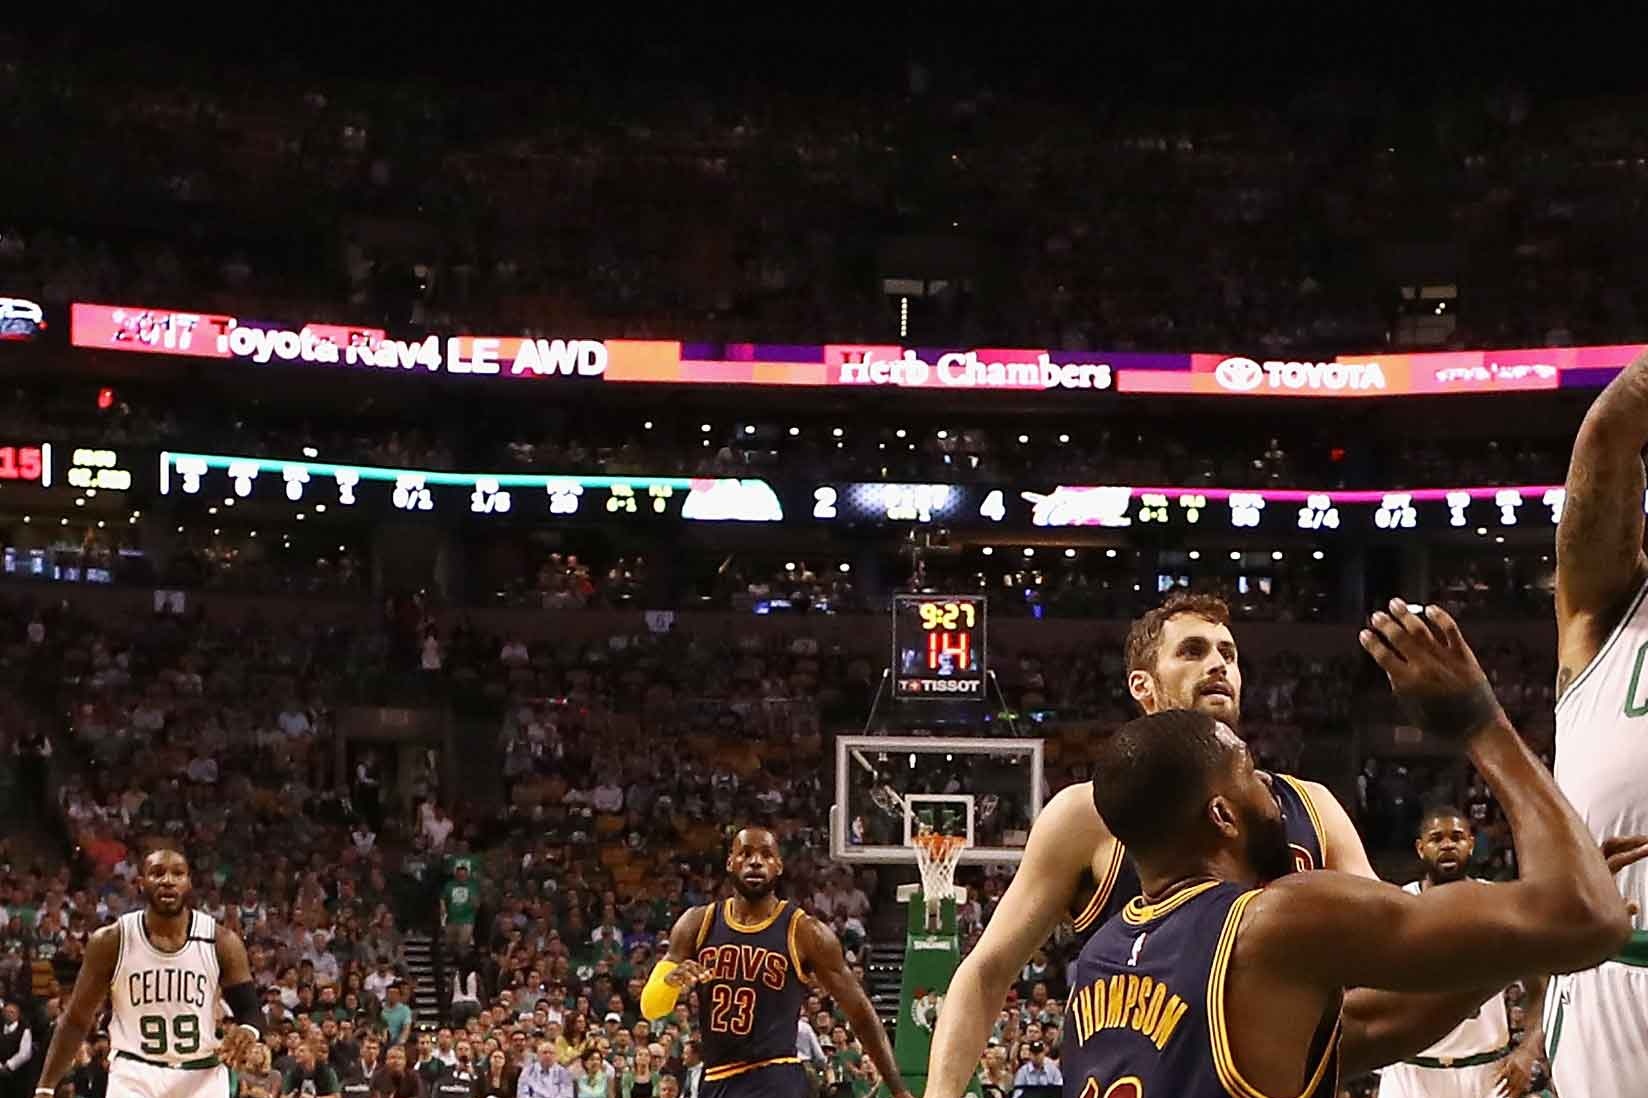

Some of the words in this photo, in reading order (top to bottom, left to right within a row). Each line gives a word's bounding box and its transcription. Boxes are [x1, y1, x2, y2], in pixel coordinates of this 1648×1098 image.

[208, 317, 340, 364] Toyota
[345, 330, 442, 372] Rav4
[448, 336, 500, 374] LE
[511, 338, 608, 376] AWD
[839, 350, 930, 385] Herb
[937, 351, 1112, 389] Chambers
[1263, 362, 1386, 389] TOYOTA
[813, 486, 838, 518] 2
[979, 490, 1006, 521] 4
[1297, 507, 1340, 529] 2/4
[919, 603, 976, 630] 9:27
[928, 632, 975, 670] 14
[924, 679, 980, 692] TISSOT
[699, 944, 788, 990] CAVS
[128, 968, 206, 1008] CELTICS
[711, 984, 756, 1035] 23
[1072, 974, 1189, 1052] THOMPSON
[140, 1014, 204, 1054] 99
